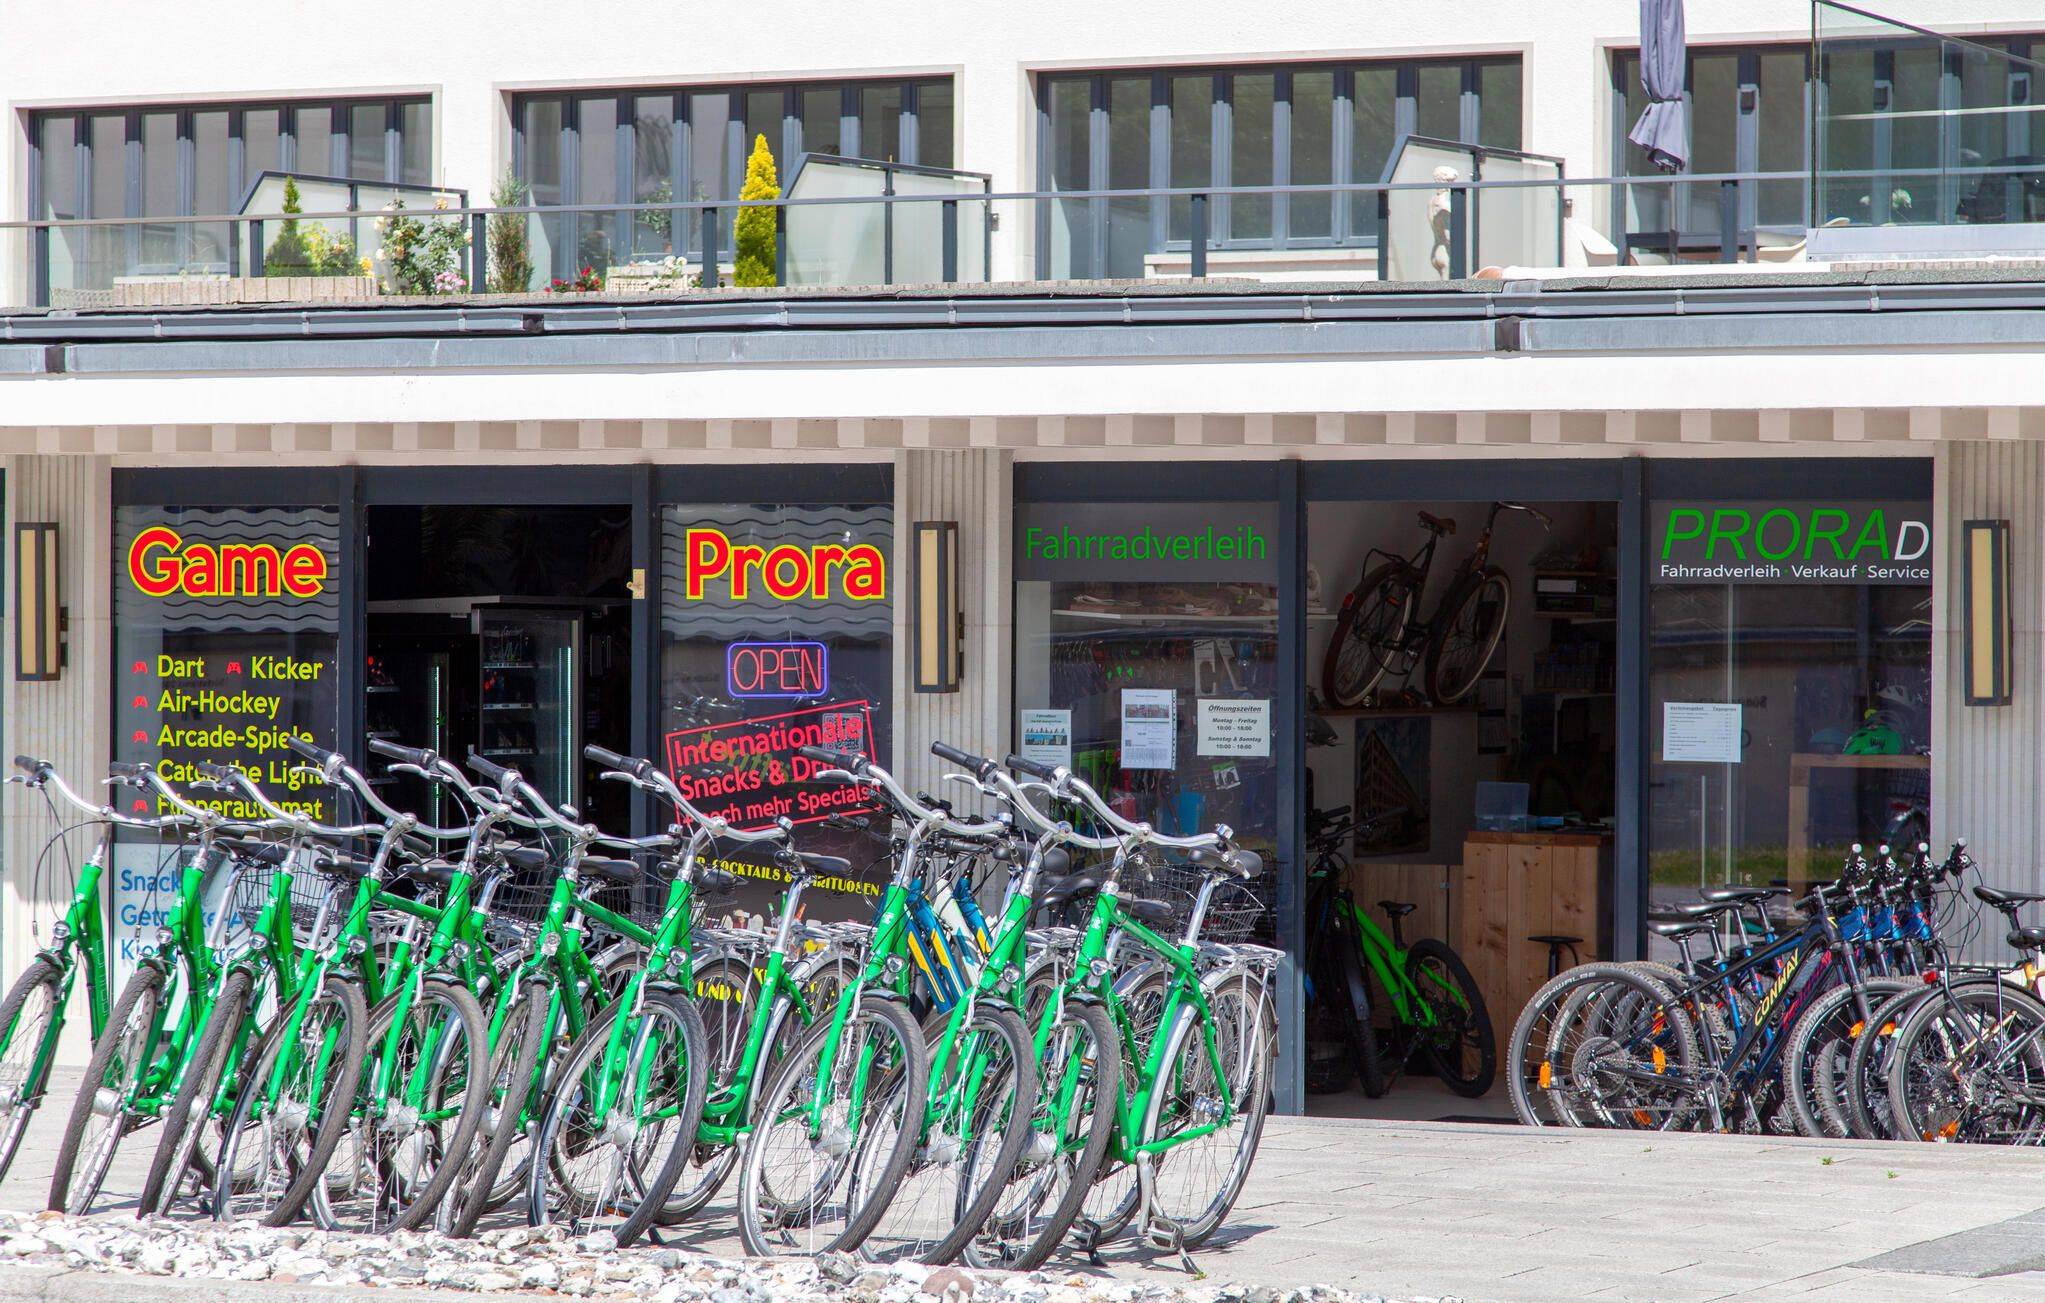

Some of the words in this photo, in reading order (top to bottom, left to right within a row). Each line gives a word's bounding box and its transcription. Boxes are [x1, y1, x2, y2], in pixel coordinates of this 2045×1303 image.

[1027, 526, 1266, 560] Fahrradverleih
[128, 527, 328, 598] Game
[686, 528, 885, 601] Prora
[1660, 564, 1781, 578] Fahrradverleih
[1791, 564, 1857, 578] Verkauf
[1867, 565, 1930, 579] Service
[157, 655, 205, 678] Dart
[251, 656, 323, 680] Kicker
[733, 648, 822, 691] OPEN
[157, 690, 281, 720] Air-Hockey
[1208, 704, 1262, 713] Öffnungszeiten
[674, 712, 863, 768] Internationale
[679, 765, 761, 801] Snacks
[769, 759, 786, 786] &
[746, 796, 793, 820] mehr
[797, 785, 870, 815] Specials
[1754, 947, 1799, 1026] CONWAY
